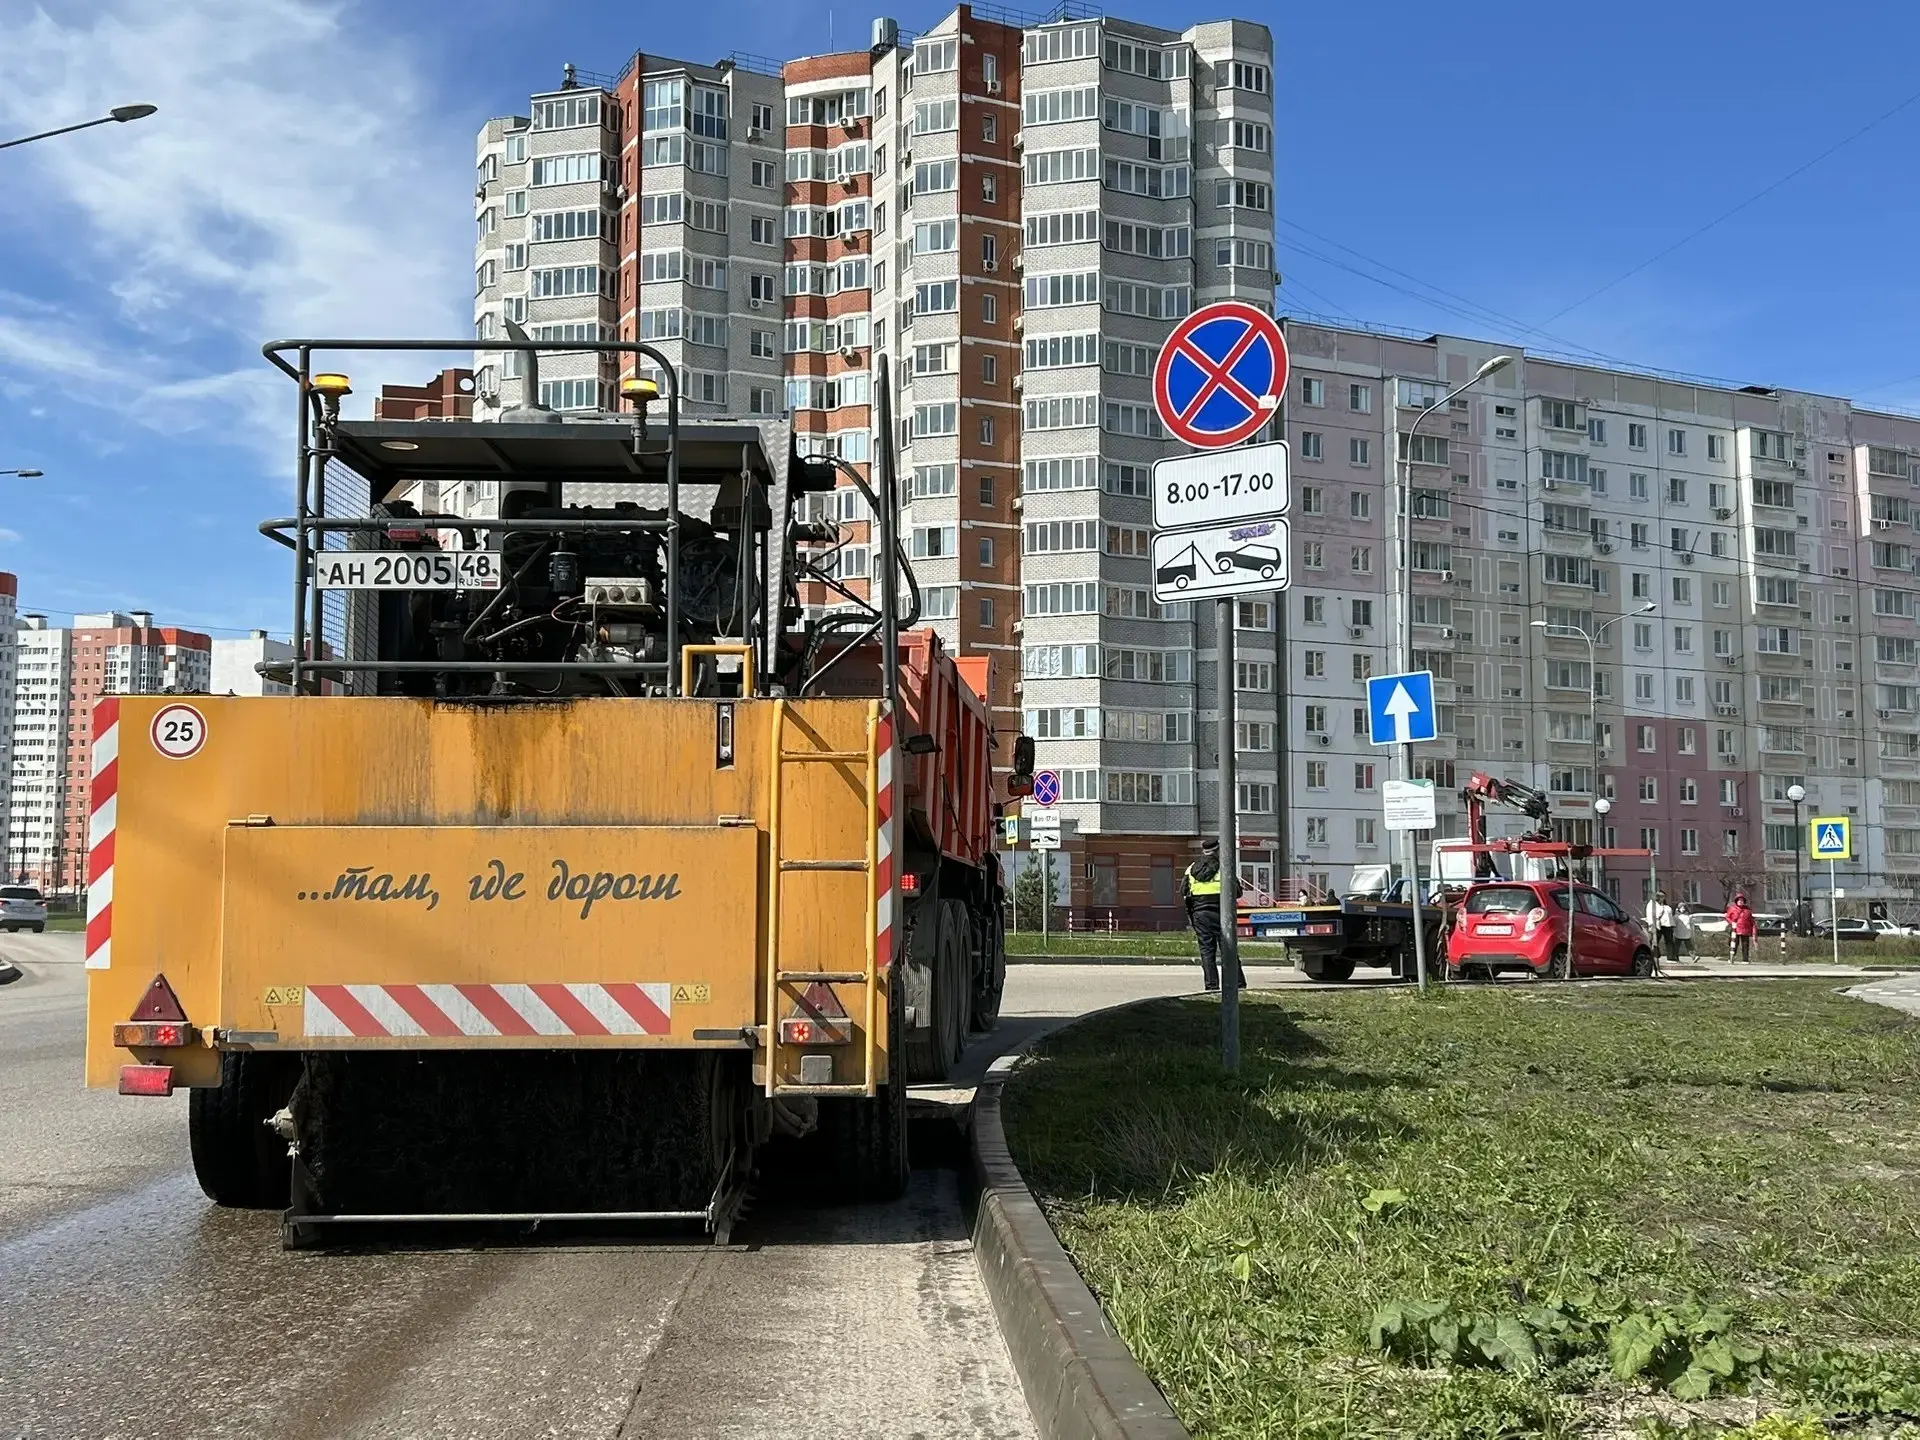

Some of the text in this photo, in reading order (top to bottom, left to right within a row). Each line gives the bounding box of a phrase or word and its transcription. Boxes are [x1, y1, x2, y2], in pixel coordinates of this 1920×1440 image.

[374, 556, 451, 585] 2005
[460, 555, 490, 577] 48
[458, 578, 480, 587] RUS
[164, 721, 194, 742] 25
[468, 859, 526, 901] где
[547, 859, 682, 920] дороги
